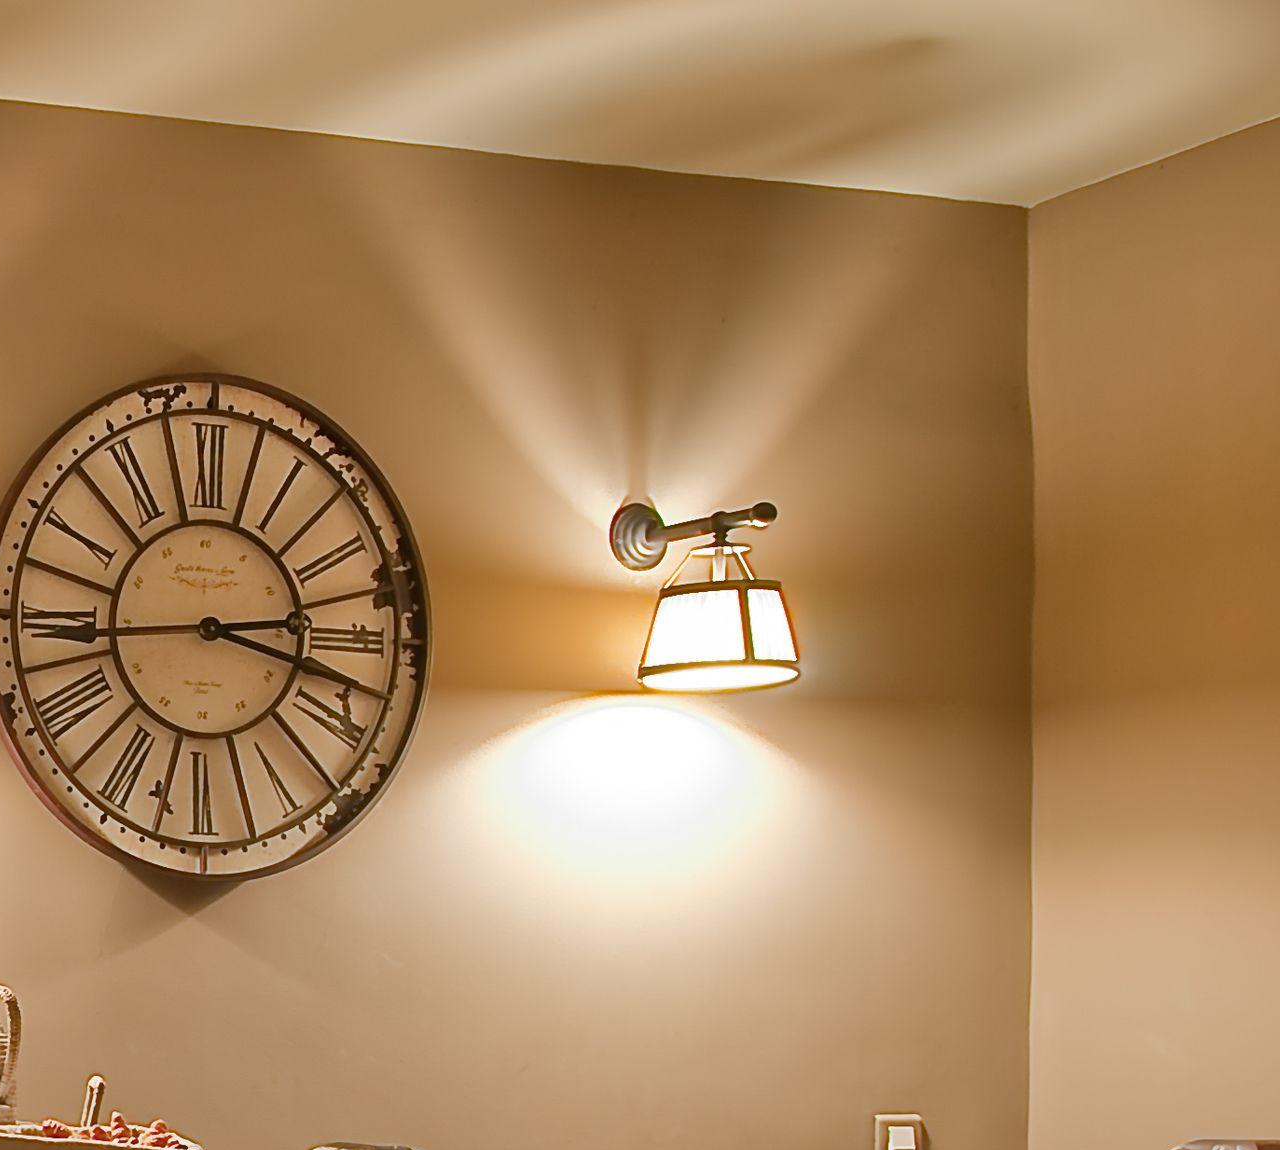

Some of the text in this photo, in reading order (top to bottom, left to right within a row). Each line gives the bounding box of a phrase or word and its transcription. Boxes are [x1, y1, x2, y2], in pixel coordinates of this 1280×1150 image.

[104, 435, 165, 528] XI
[190, 421, 229, 510] XII
[42, 506, 119, 570] X
